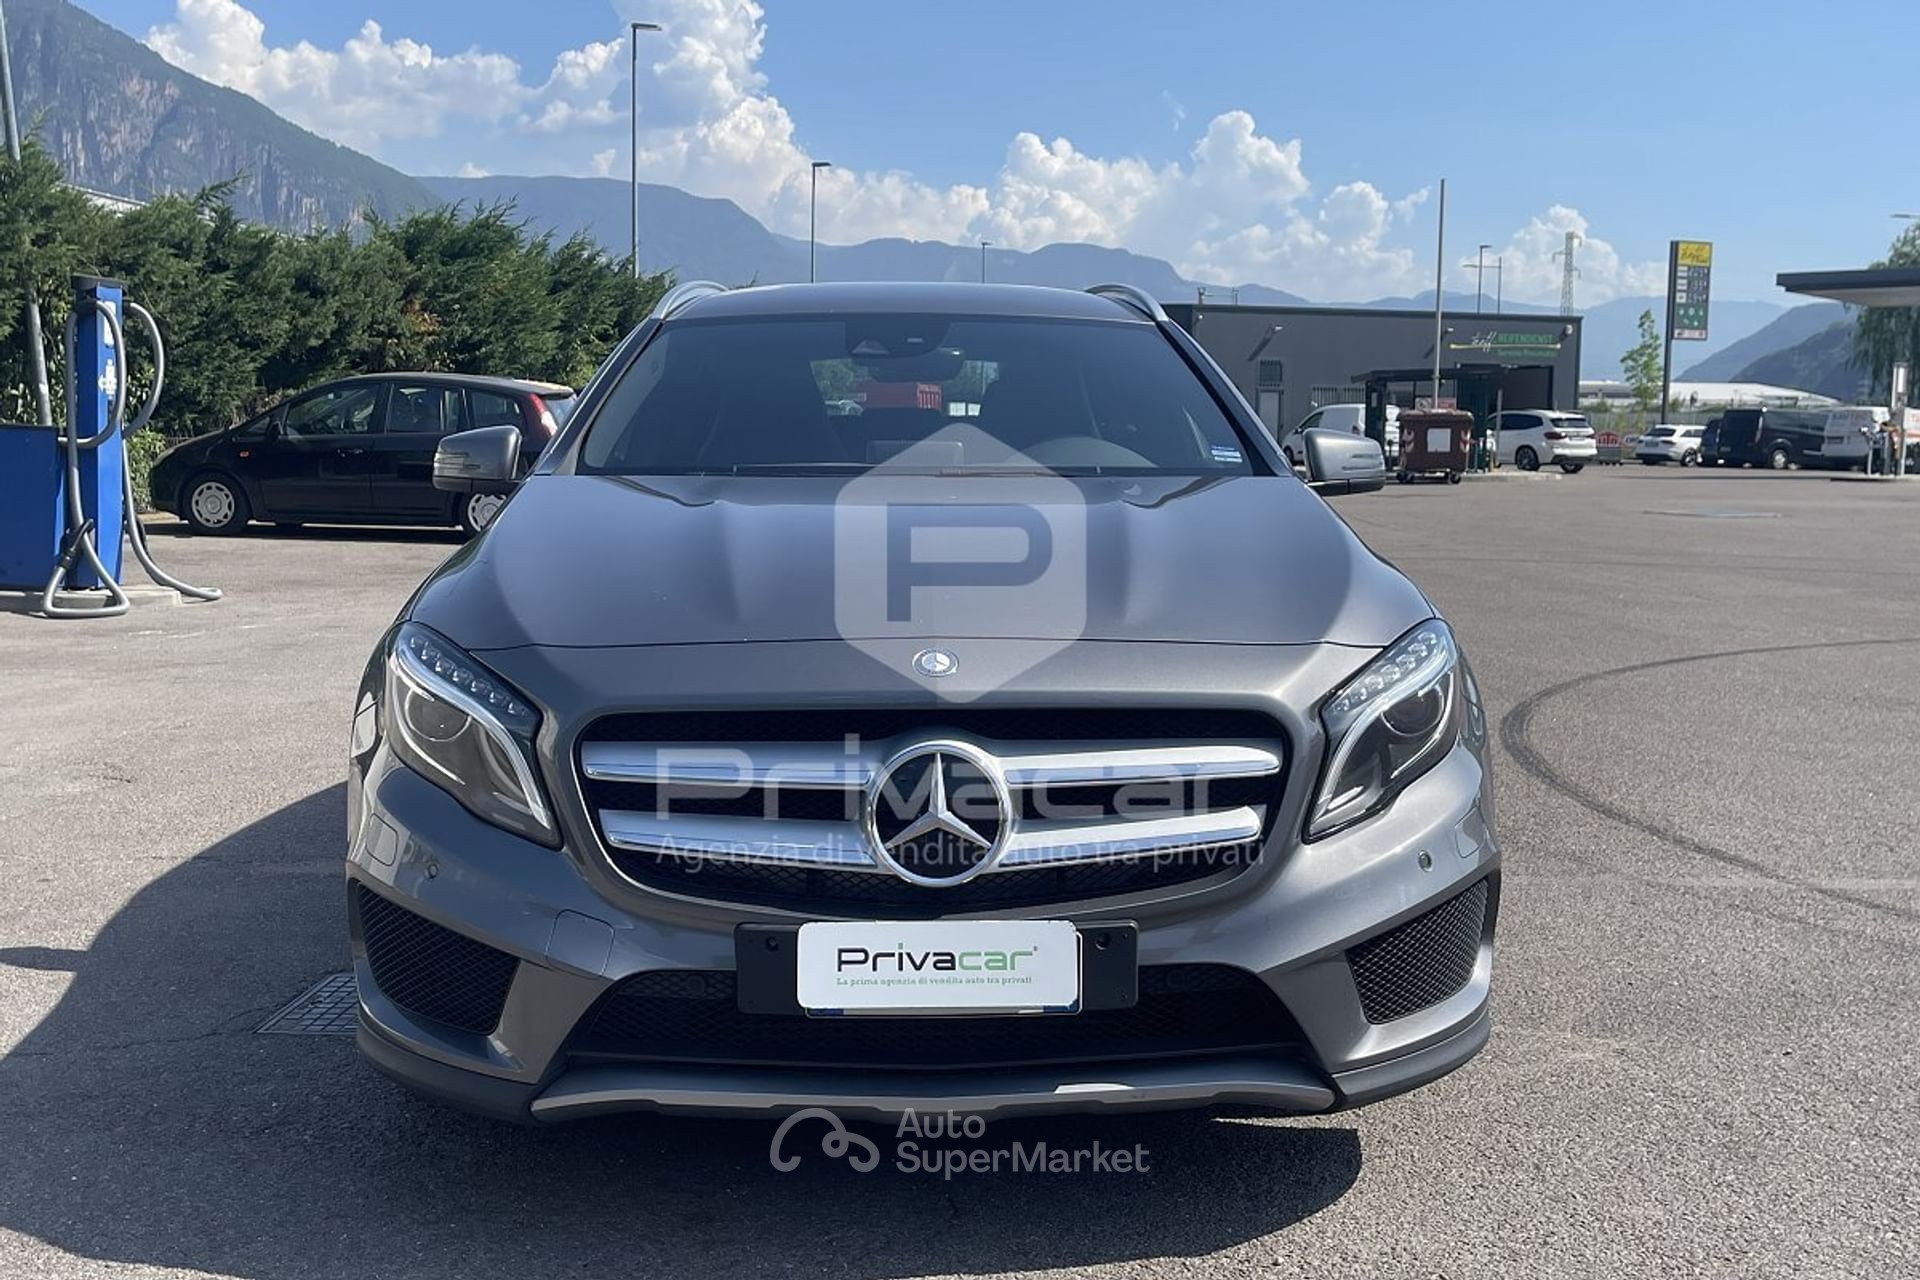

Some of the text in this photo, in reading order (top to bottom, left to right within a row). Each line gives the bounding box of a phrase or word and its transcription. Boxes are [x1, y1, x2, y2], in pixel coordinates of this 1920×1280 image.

[850, 977, 878, 987] prima
[929, 976, 963, 984] vendita
[987, 976, 1000, 984] tra
[1002, 976, 1032, 986] privati
